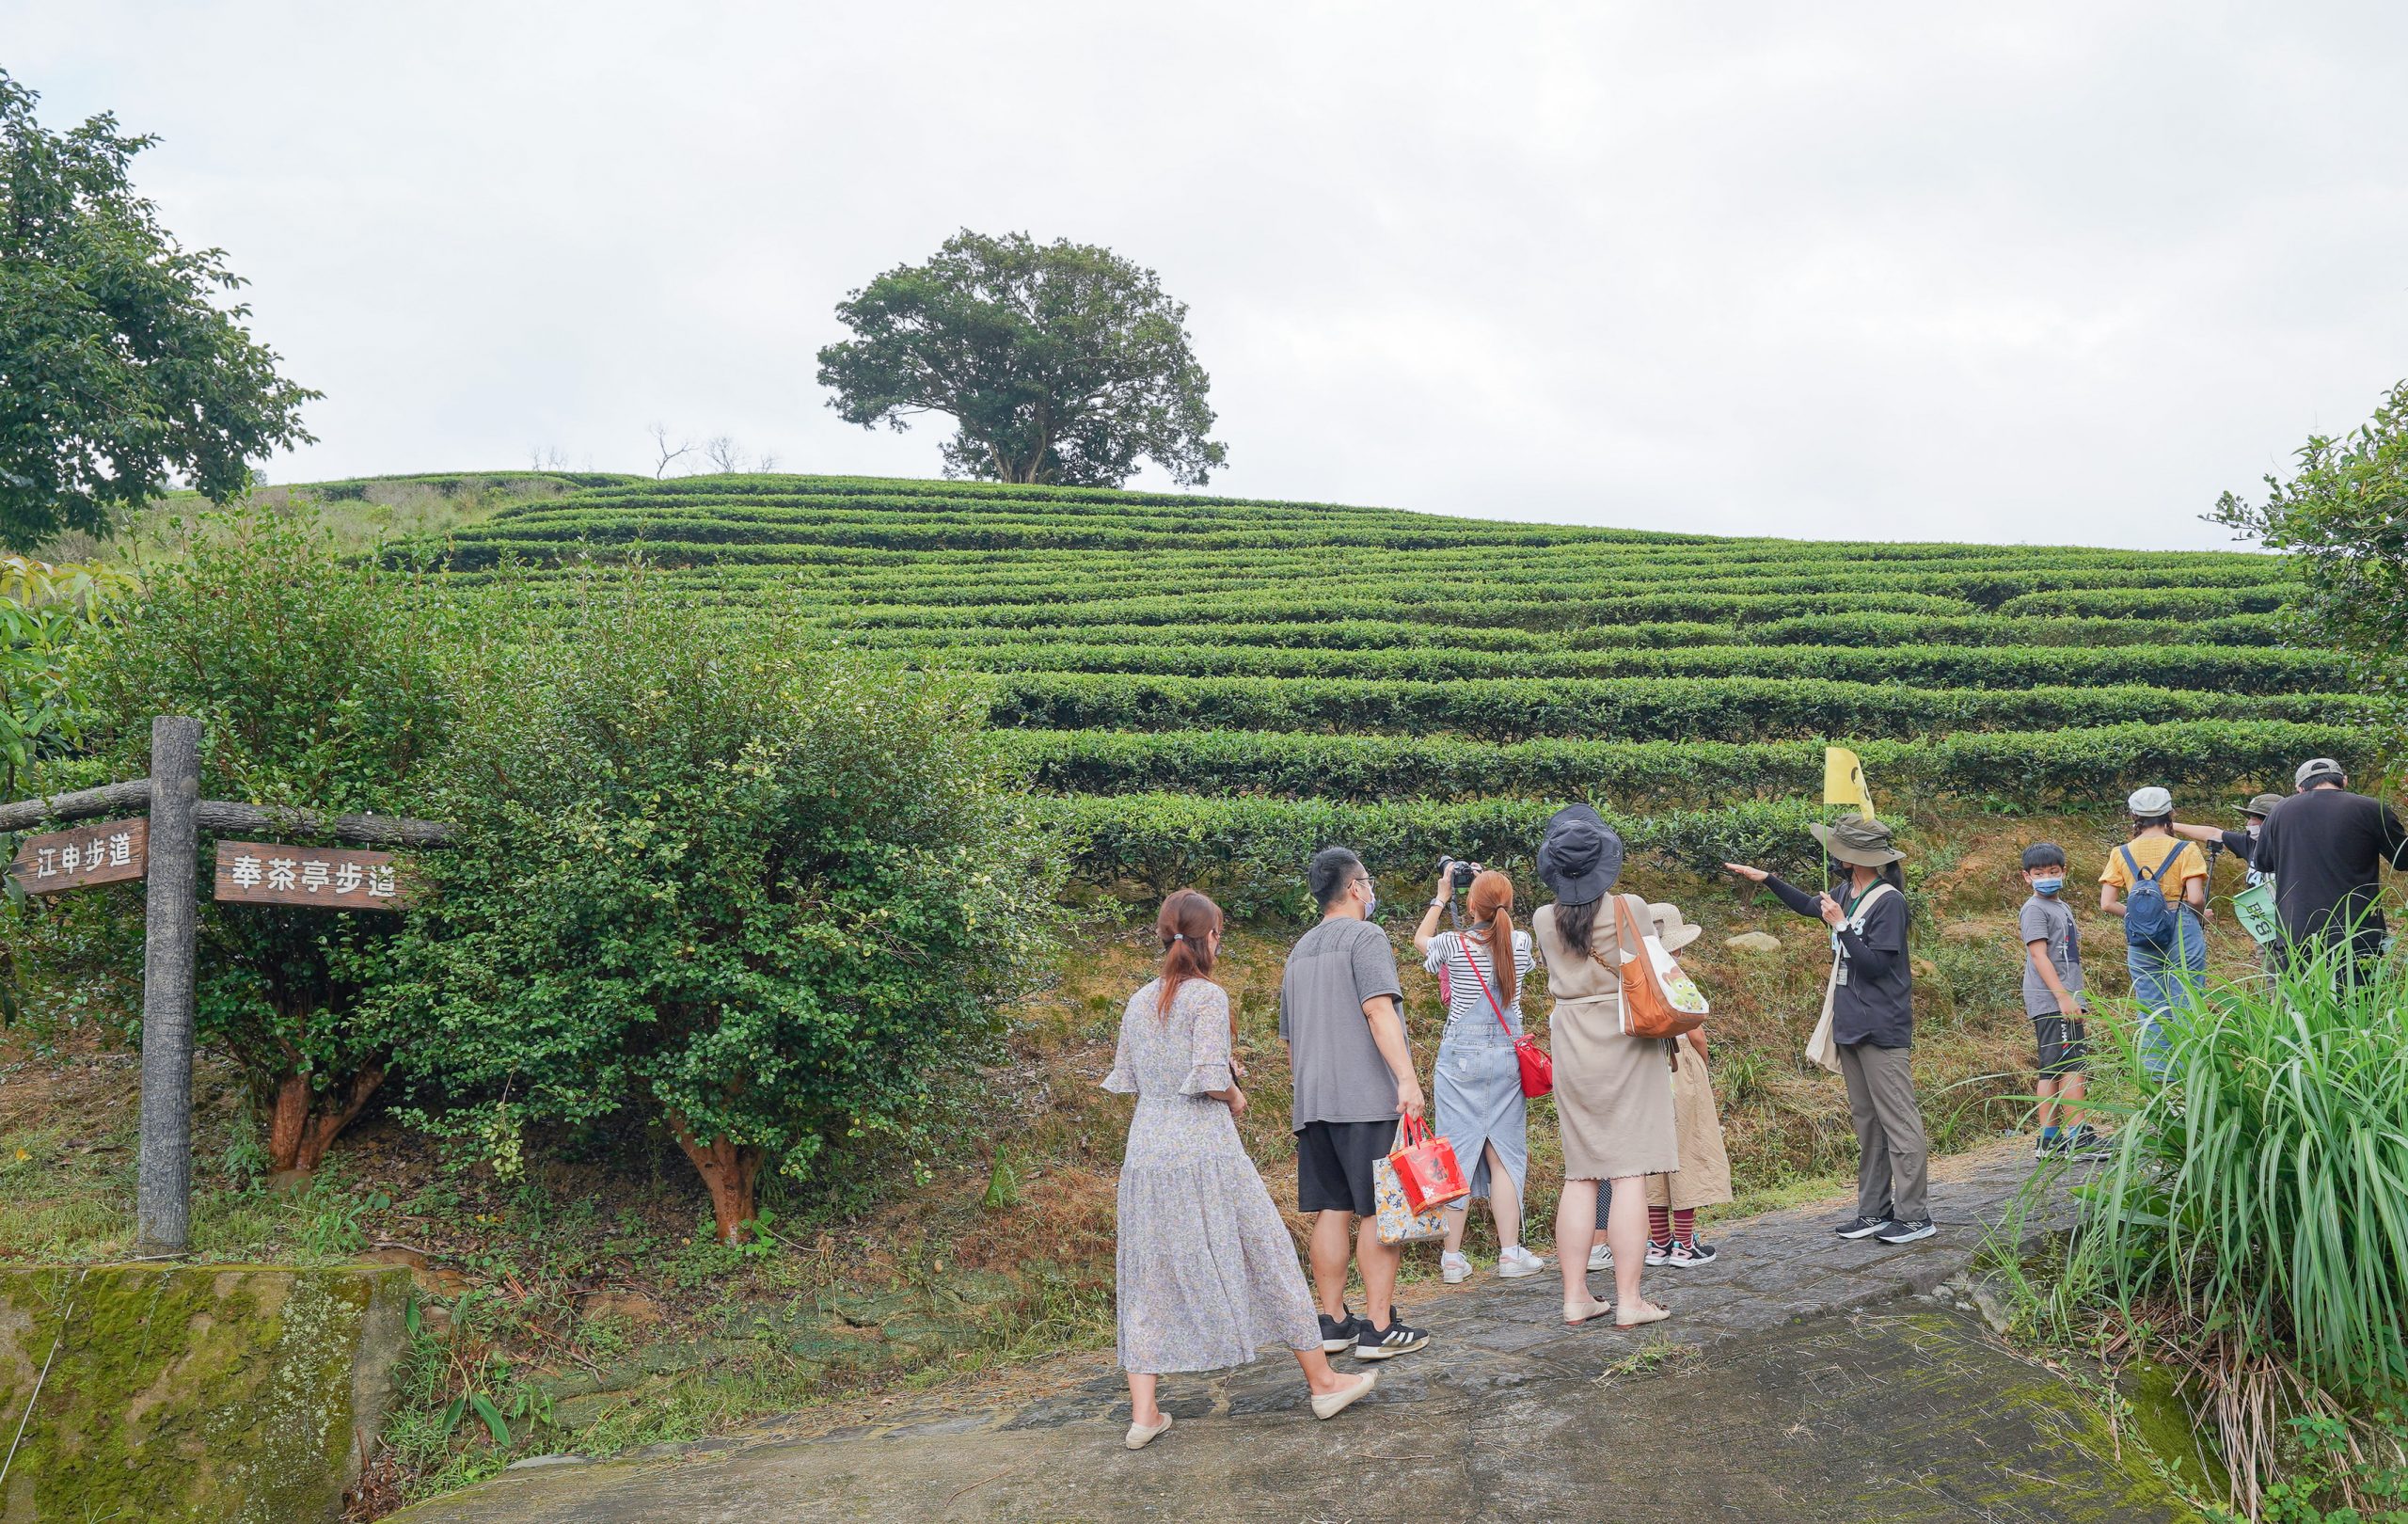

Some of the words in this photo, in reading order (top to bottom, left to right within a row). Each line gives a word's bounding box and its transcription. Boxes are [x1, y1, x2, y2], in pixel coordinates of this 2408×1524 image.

[37, 832, 132, 880] 江申步道
[231, 855, 397, 897] 奉茶亭步道
